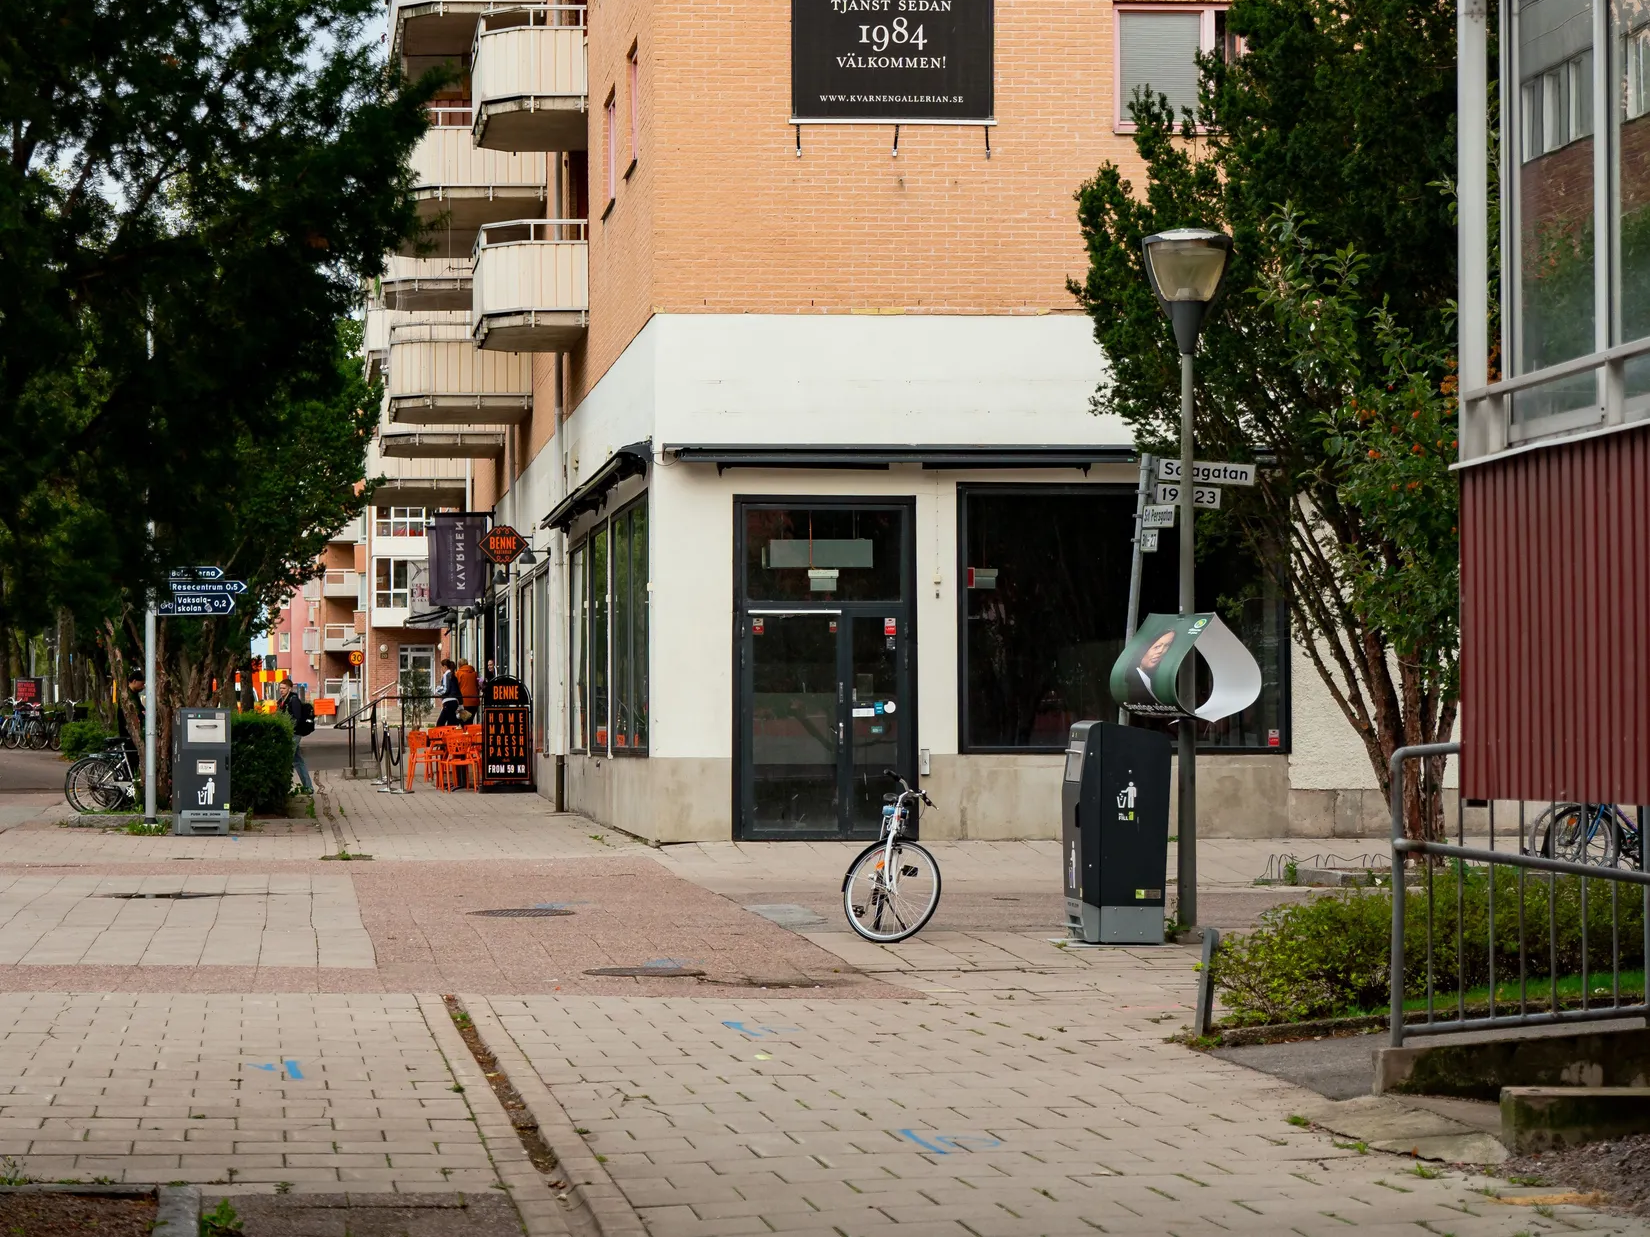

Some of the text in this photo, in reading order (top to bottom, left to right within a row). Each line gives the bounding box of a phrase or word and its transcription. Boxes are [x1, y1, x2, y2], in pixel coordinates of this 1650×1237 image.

[898, 0, 952, 11] SEDAN
[858, 16, 928, 52] 1984
[836, 53, 946, 69] VÄLKOMMEN!
[1164, 462, 1248, 481] Saagatan
[1162, 487, 1216, 504] 19 23
[490, 536, 517, 550] BENNE
[172, 583, 223, 591] Resecentrum
[177, 596, 211, 604] Vaksala-
[213, 600, 227, 608] 0,2
[352, 654, 362, 662] 30
[493, 685, 519, 700] BENNE
[489, 712, 523, 723] HOME
[489, 724, 524, 734] MADE
[489, 735, 524, 746] FRESH
[489, 746, 524, 757] PASTA
[488, 764, 526, 774] FROM 59 KR
